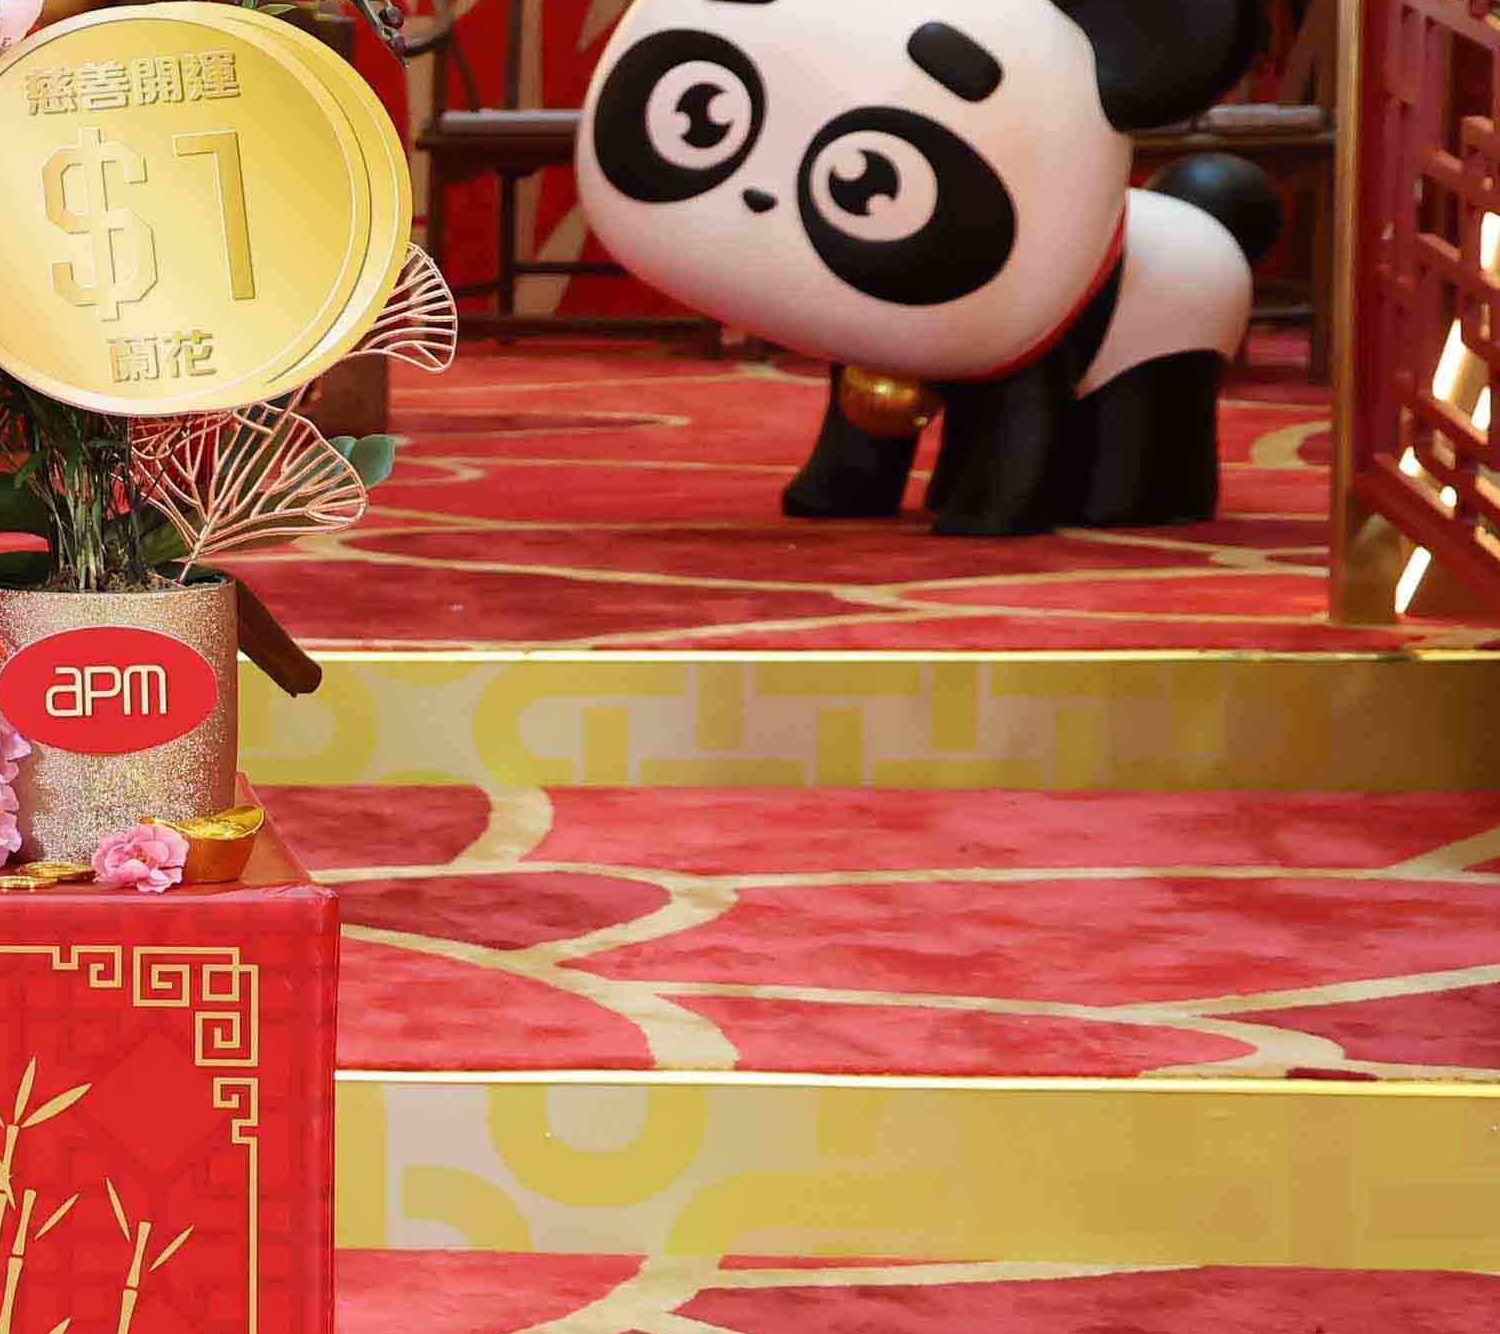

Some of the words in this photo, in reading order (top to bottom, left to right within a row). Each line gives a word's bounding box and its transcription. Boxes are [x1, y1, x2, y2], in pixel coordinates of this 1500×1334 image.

[24, 51, 241, 116] 慈善開運
[41, 123, 256, 323] $1
[106, 328, 217, 383] 蘭花
